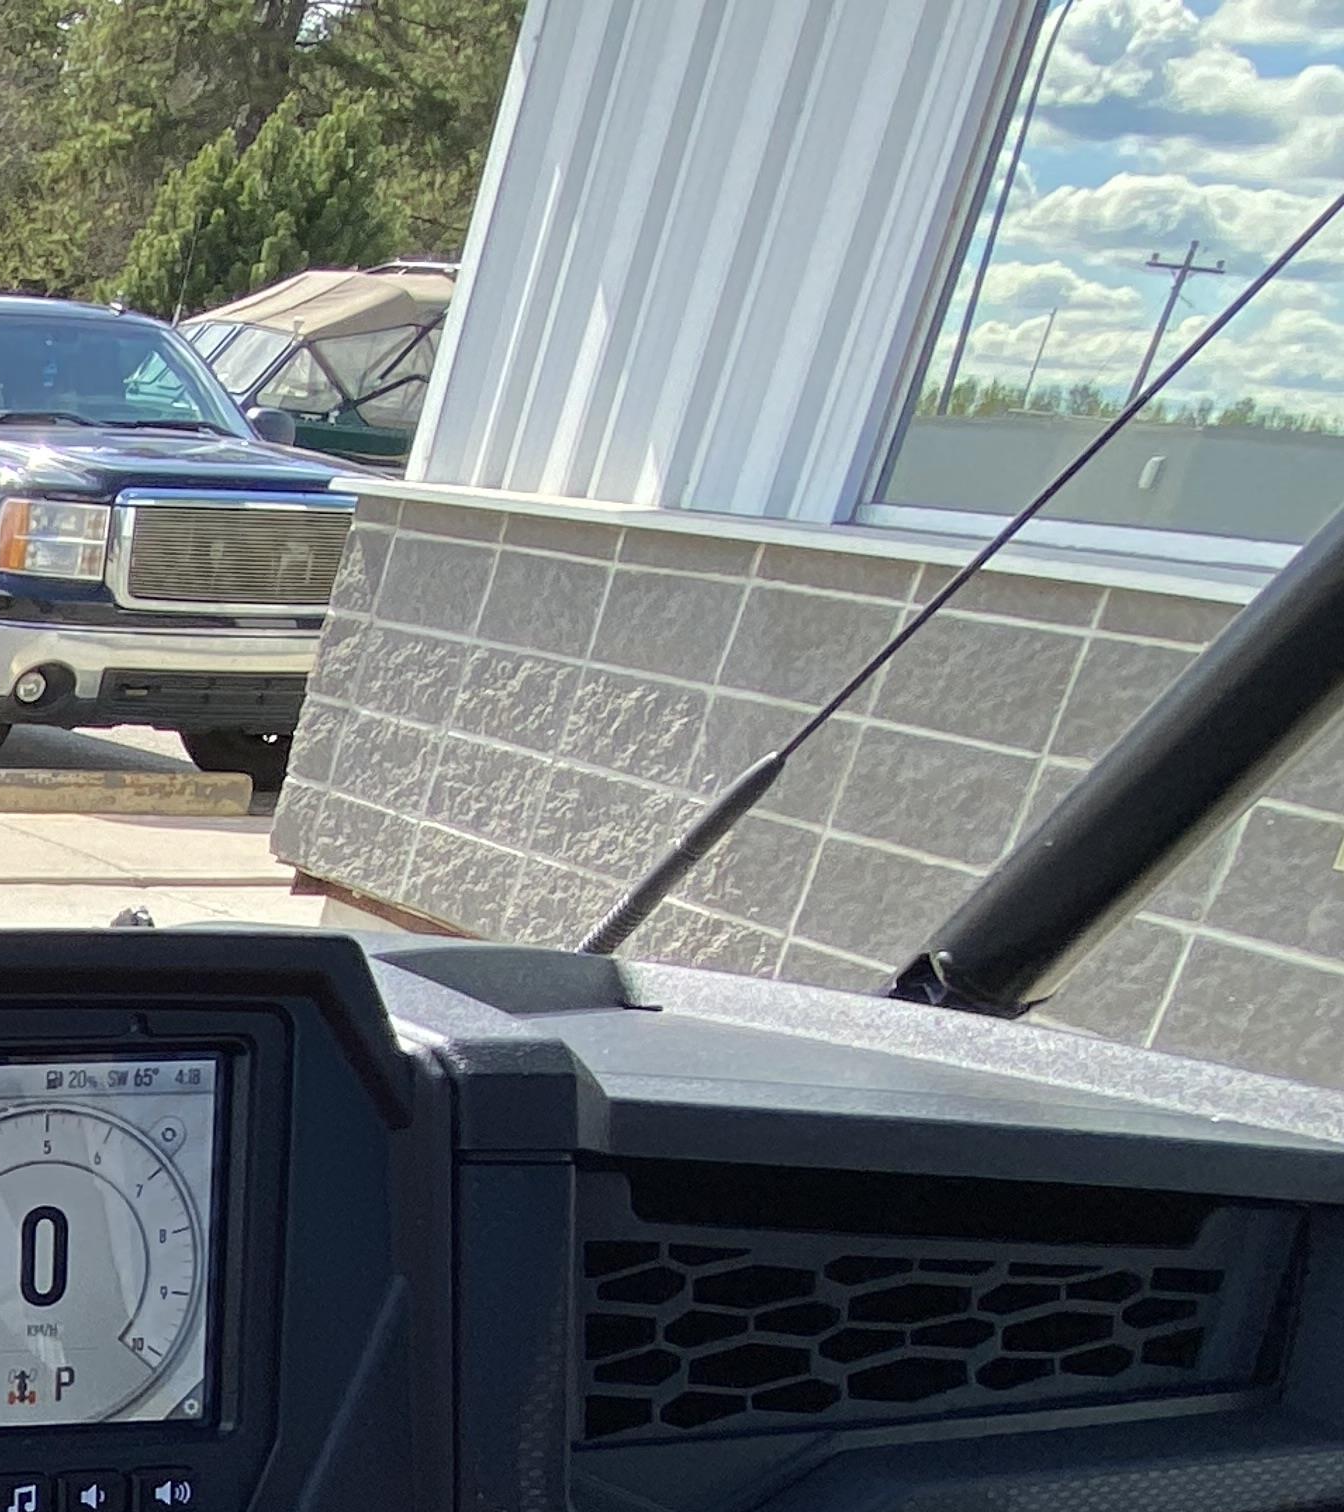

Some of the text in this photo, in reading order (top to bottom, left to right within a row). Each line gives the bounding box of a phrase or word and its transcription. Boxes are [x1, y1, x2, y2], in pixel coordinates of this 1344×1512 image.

[107, 1069, 129, 1088] SW
[174, 1069, 201, 1085] 4:18
[43, 1140, 52, 1155] 5
[94, 1152, 102, 1165] 6
[136, 1184, 143, 1198] 7
[159, 1228, 167, 1243] 8
[20, 1205, 69, 1307] 0
[160, 1286, 168, 1299] 9
[132, 1338, 144, 1351] 10
[55, 1366, 76, 1402] P
